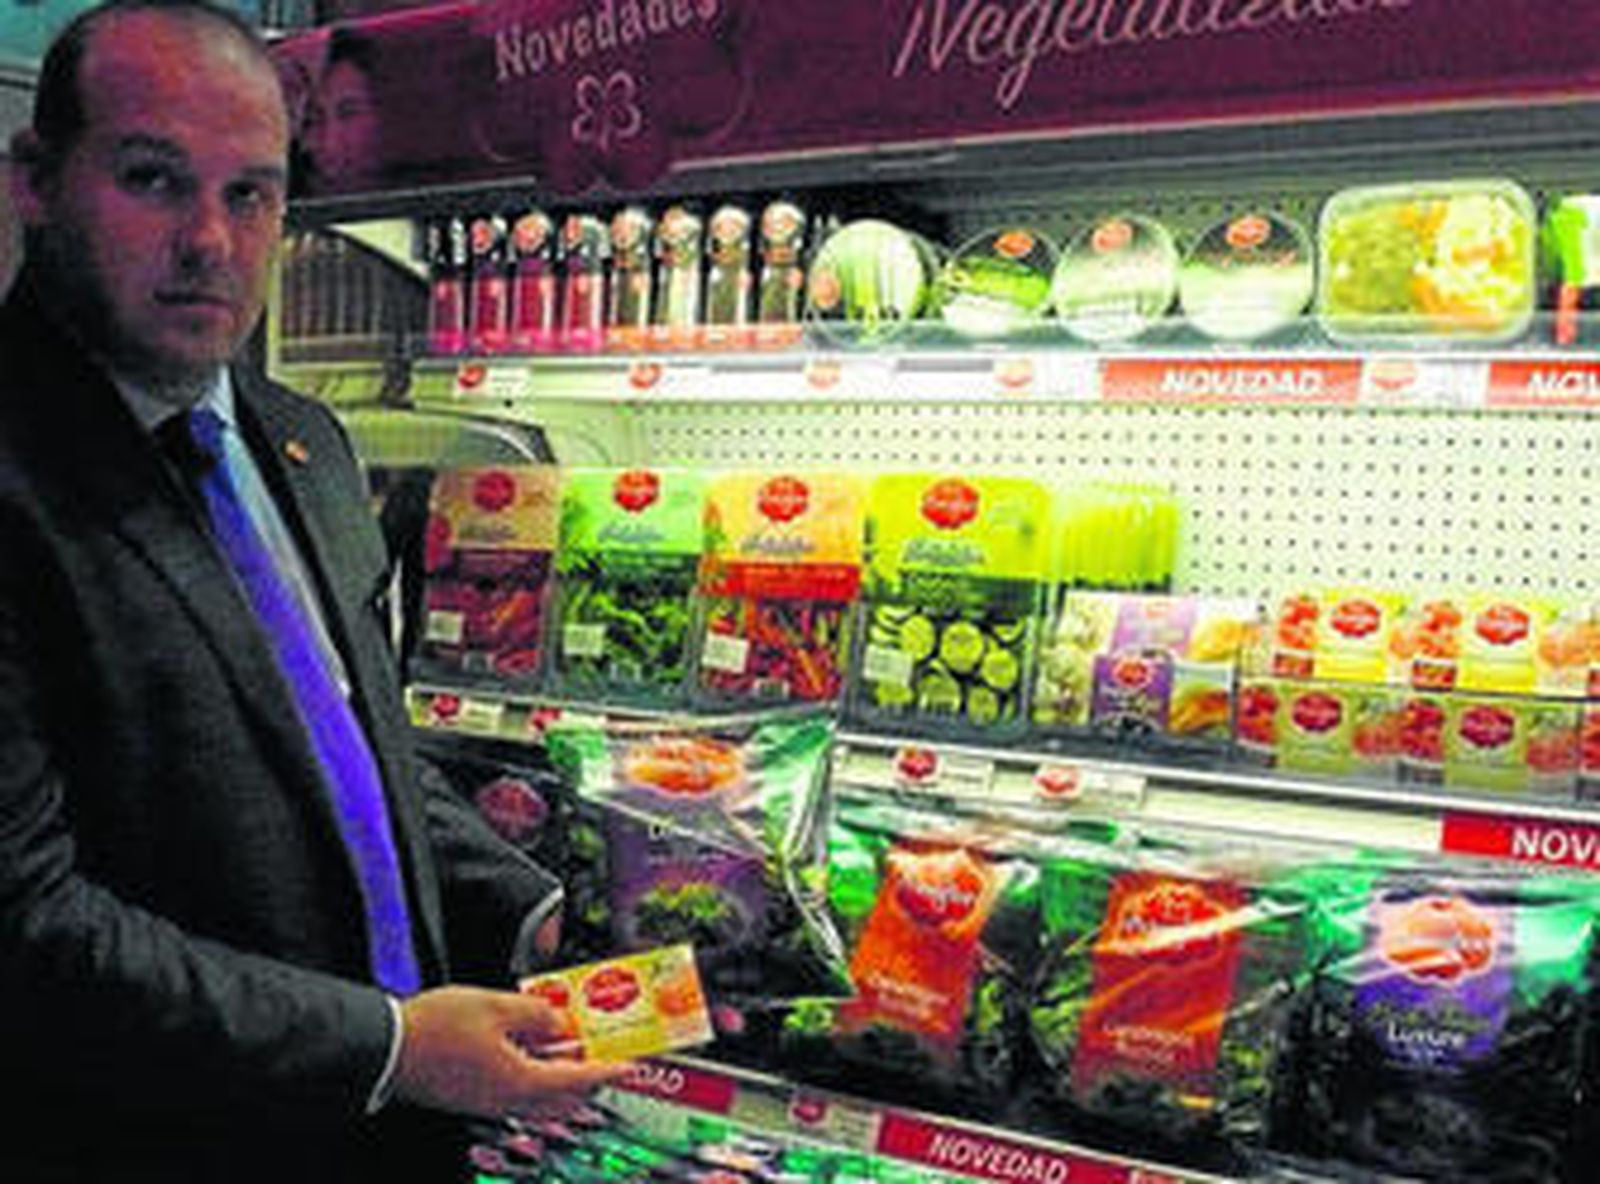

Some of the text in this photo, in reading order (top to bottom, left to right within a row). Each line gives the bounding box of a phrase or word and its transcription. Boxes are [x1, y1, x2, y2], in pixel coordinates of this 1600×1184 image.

[495, 0, 718, 82] Novedades
[1511, 826, 1600, 862] NOV
[927, 1133, 1070, 1184] NOVEDAD
